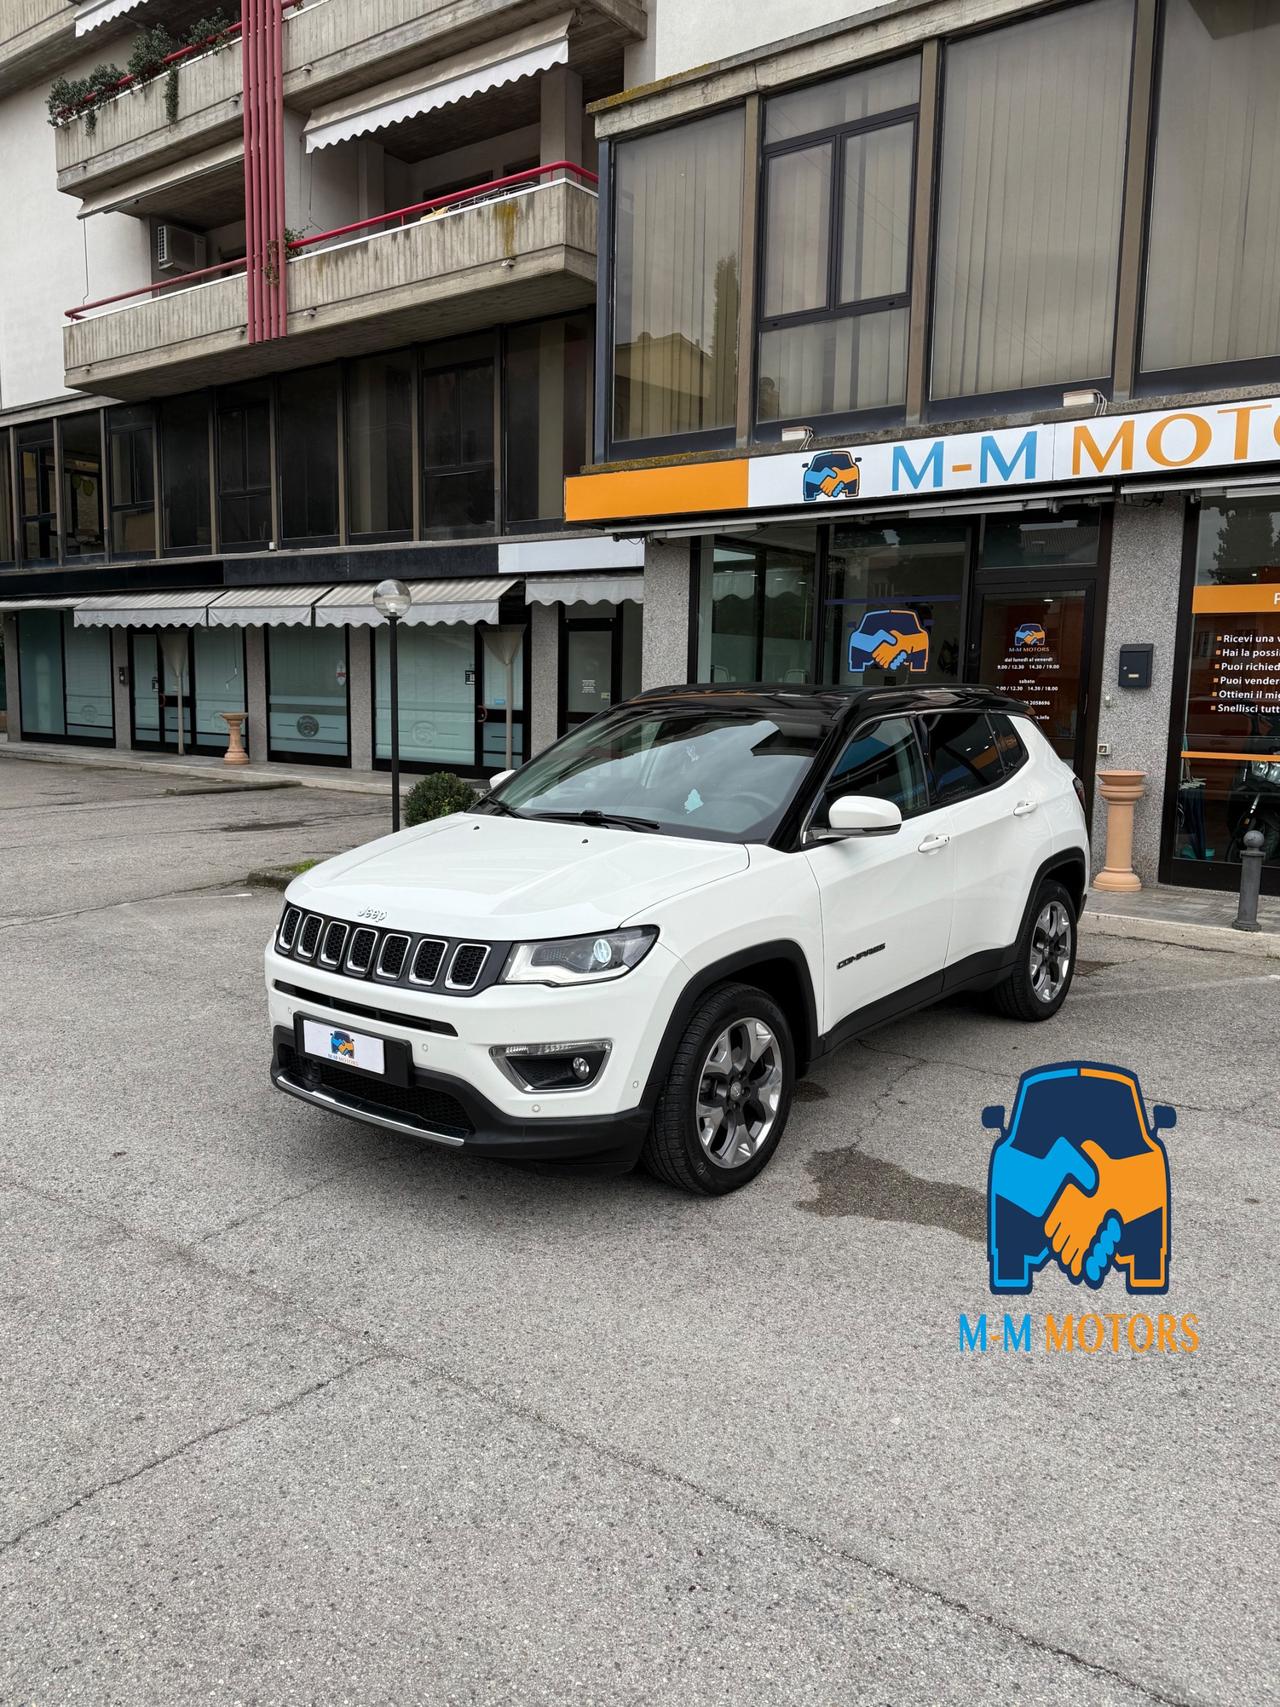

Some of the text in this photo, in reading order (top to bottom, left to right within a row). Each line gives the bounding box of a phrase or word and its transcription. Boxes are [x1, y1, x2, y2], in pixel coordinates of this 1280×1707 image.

[891, 404, 1280, 492] M-M MOT
[1223, 634, 1253, 643] Ricevi
[1222, 648, 1280, 659] Hai la possi
[1221, 662, 1243, 671] Puoi
[1220, 676, 1280, 685] Puoi vender
[1218, 690, 1253, 699] Ottieni
[1256, 690, 1262, 699] il
[1218, 704, 1258, 713] Snellisci
[357, 905, 387, 923] Jeep
